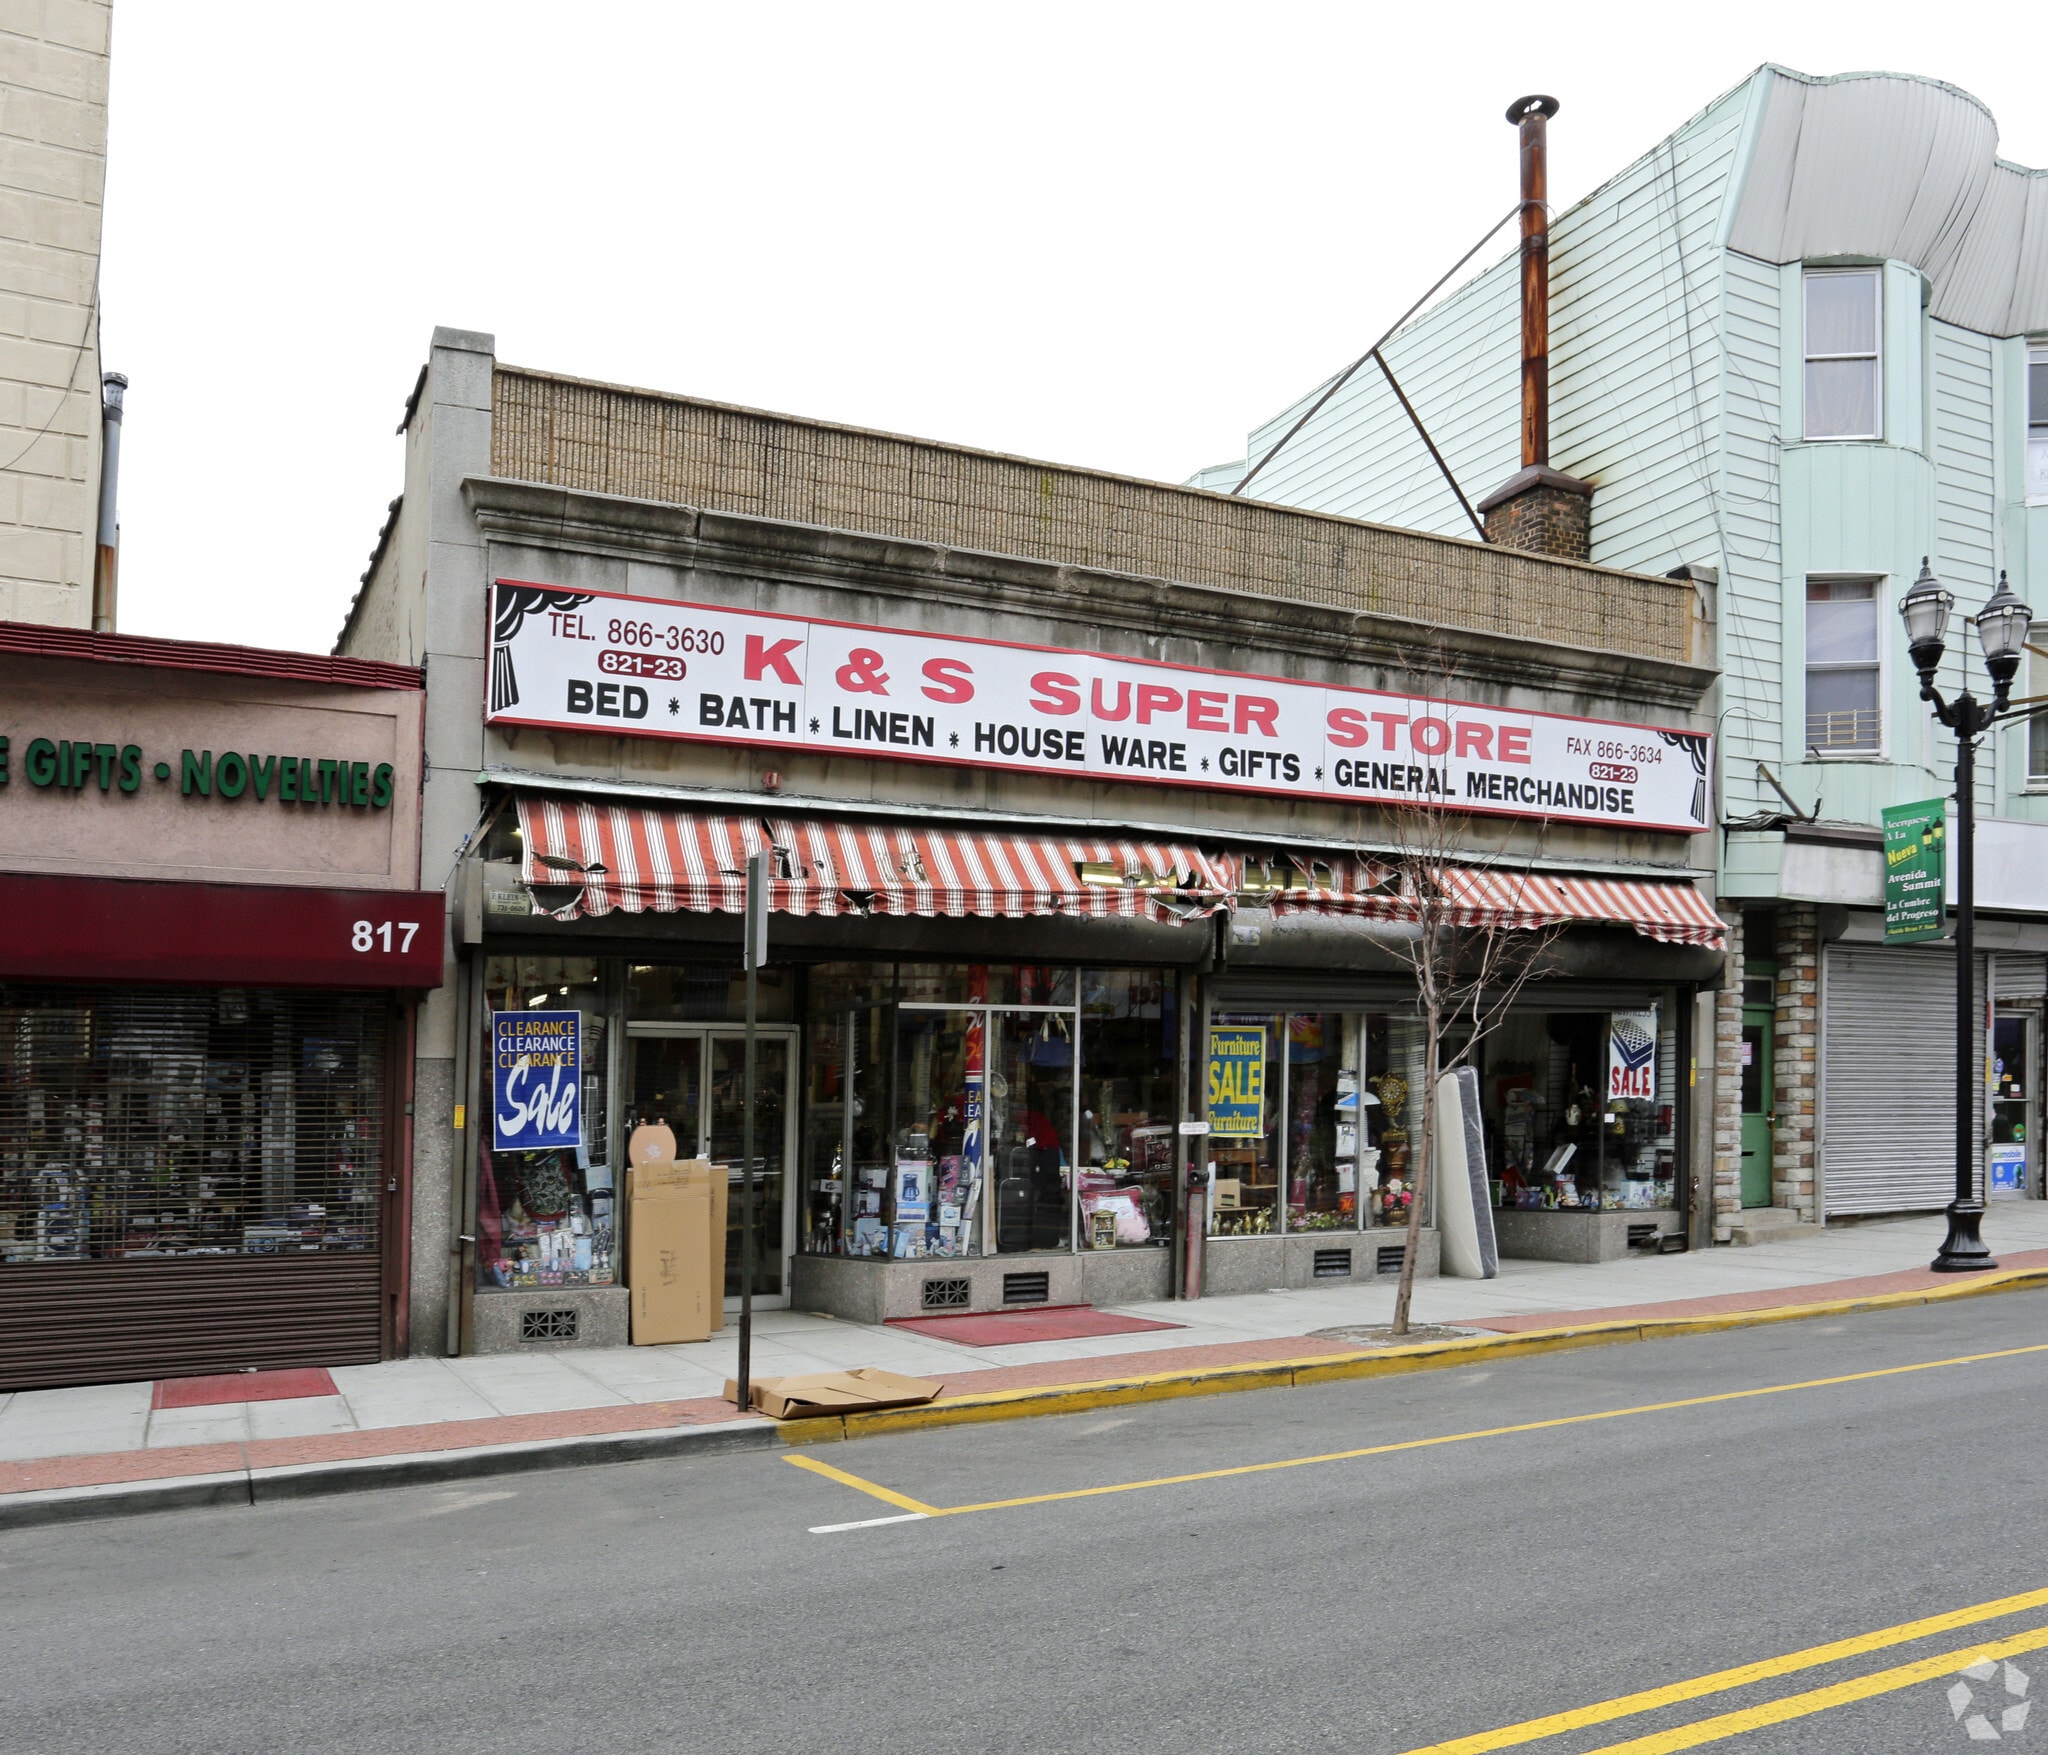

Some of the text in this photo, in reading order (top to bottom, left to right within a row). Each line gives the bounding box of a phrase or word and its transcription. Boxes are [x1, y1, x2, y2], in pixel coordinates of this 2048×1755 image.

[548, 611, 725, 656] TEL. 866-3630
[602, 652, 683, 678] 821-23
[744, 634, 1532, 765] K & S SUPER STORE
[567, 679, 1635, 814] BED BATH LINEN HOUSE WARE GIFTS GENERAL MERCHANDISE
[1566, 736, 1664, 765] FAX 866-3634
[25, 737, 143, 793] GIFTS
[181, 748, 395, 809] NOVELTIES
[1590, 765, 1638, 782] 821-23
[1894, 830, 1907, 841] La
[1887, 844, 1917, 866] Nueva
[1887, 869, 1928, 884] Avenida
[1902, 877, 1942, 892] Summit
[1886, 897, 1932, 912] La Cumbre
[1886, 909, 1940, 923] del Progreso
[351, 919, 421, 954] 817
[498, 1020, 576, 1037] CLEARANCE
[498, 1036, 576, 1053] CLEARANCE
[1210, 1034, 1261, 1056] Furniture
[498, 1052, 576, 1069] CLEARANCE
[1208, 1060, 1261, 1105] SALE
[1611, 1065, 1651, 1097] SALE
[498, 1054, 576, 1137] Sale
[1208, 1110, 1258, 1132] Furniture
